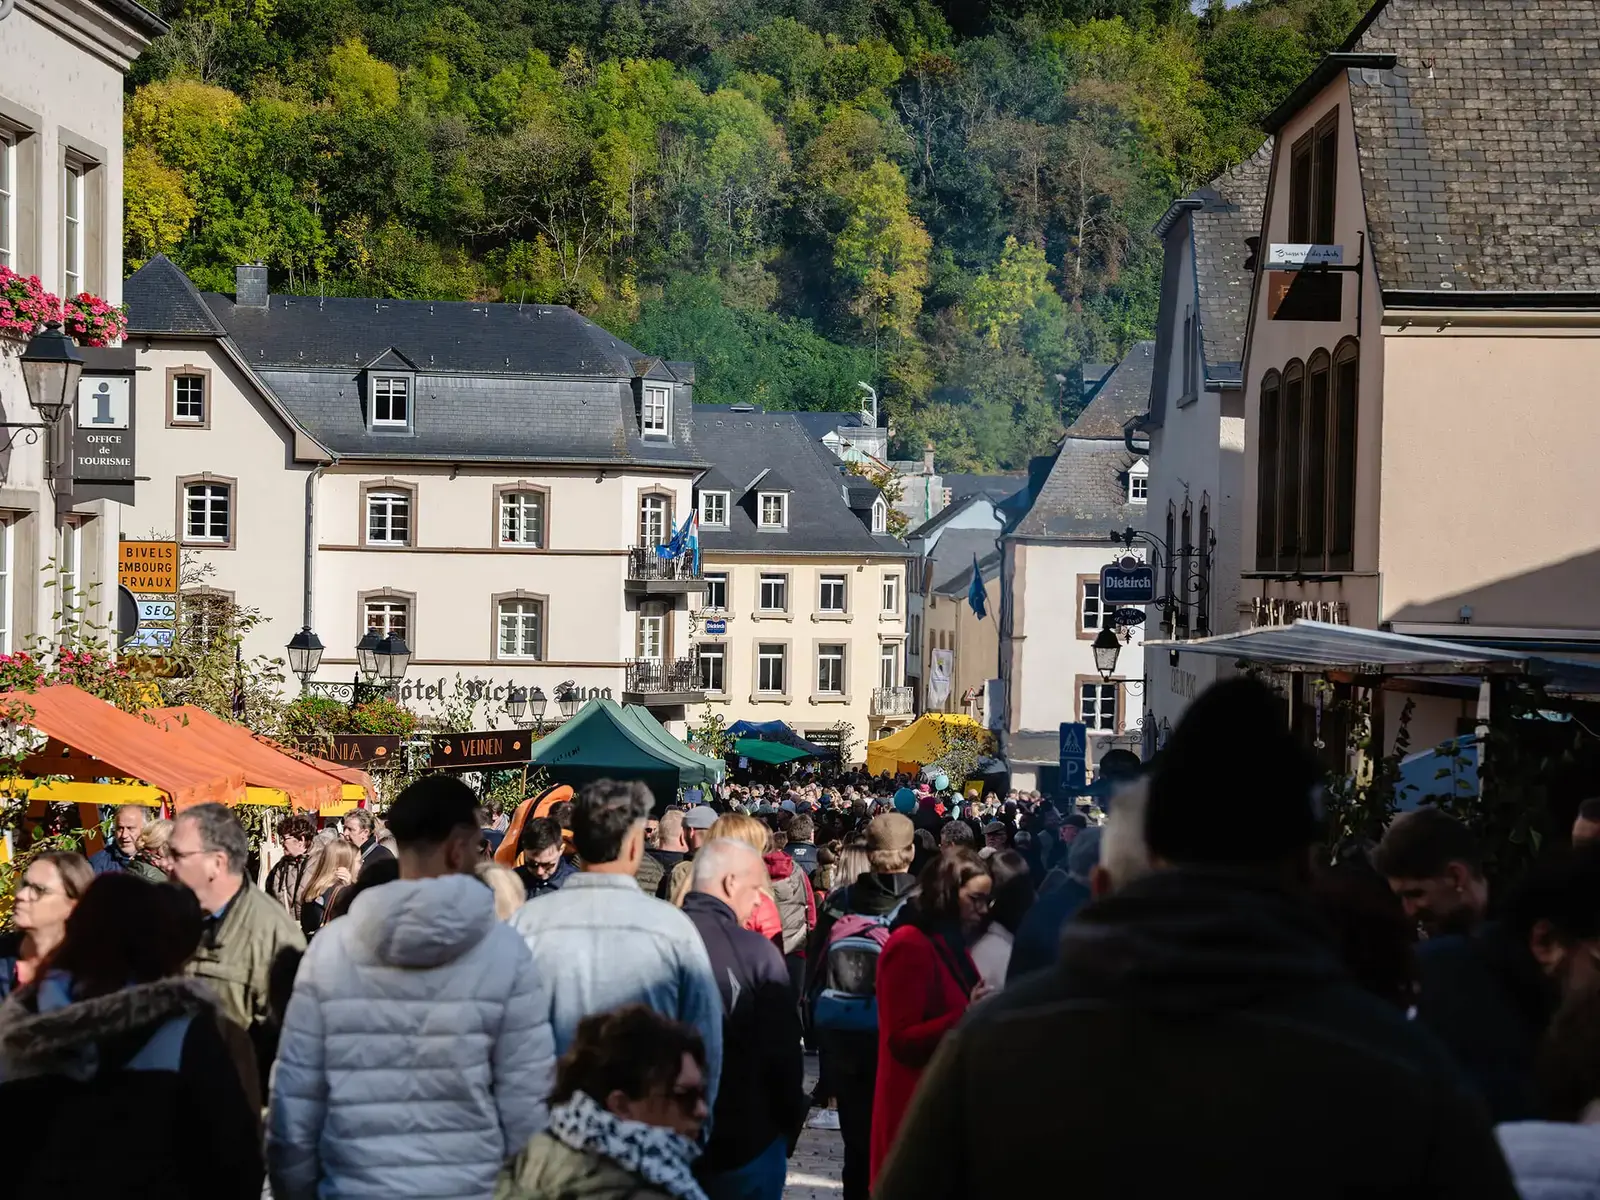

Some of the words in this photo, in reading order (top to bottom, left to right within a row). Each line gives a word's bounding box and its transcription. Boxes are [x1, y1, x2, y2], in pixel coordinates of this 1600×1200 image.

[87, 435, 122, 444] OFFICE
[99, 446, 111, 455] de
[78, 457, 131, 466] TOURISME
[126, 547, 173, 558] BIVELS
[1105, 576, 1152, 589] Diekirch
[460, 738, 503, 757] VEINEN
[1066, 760, 1079, 781] P
